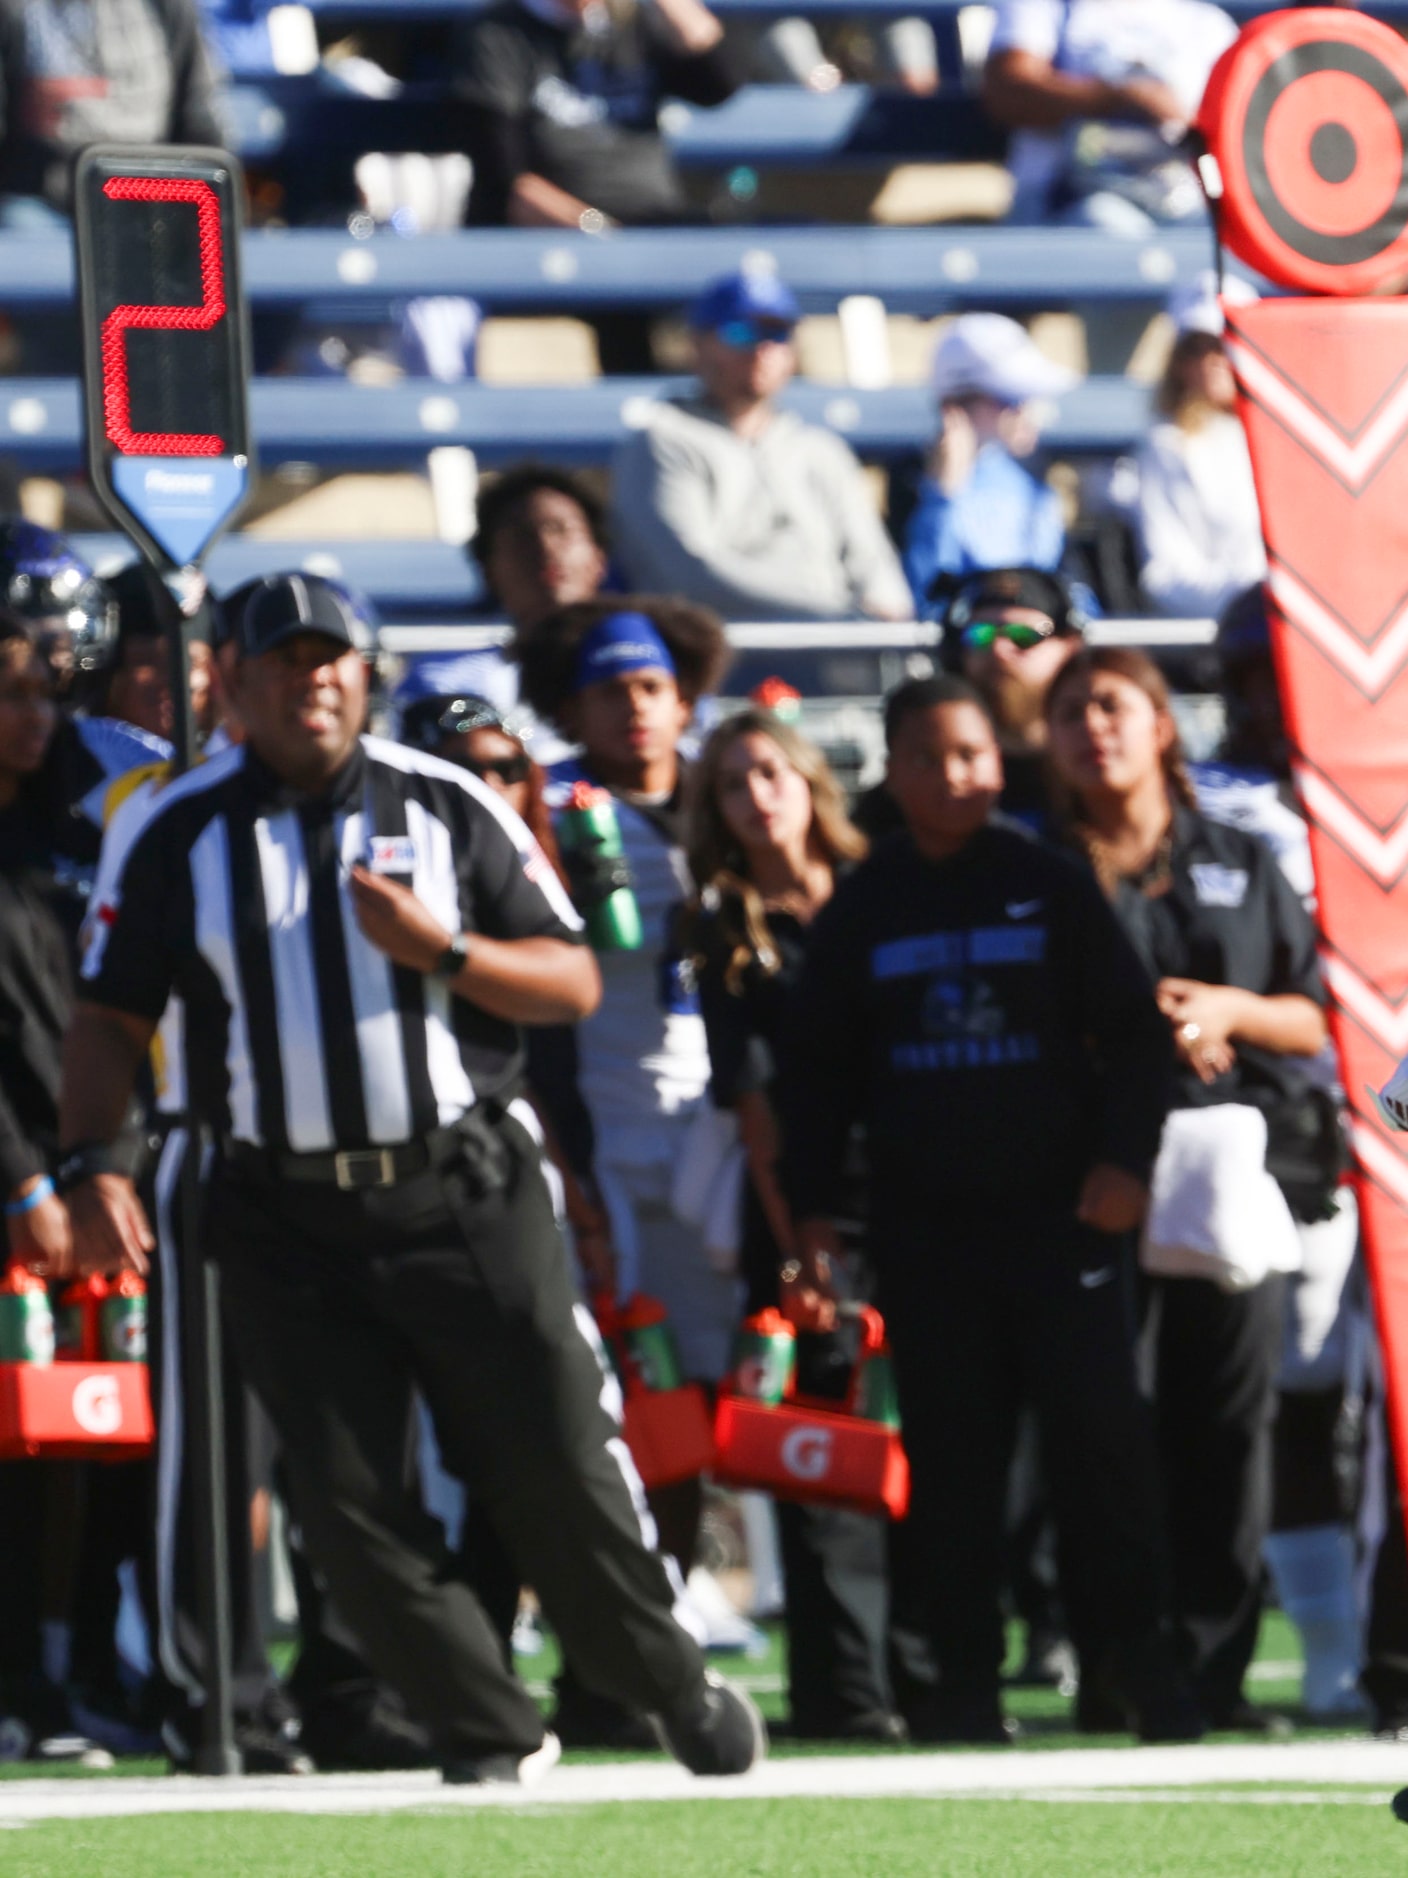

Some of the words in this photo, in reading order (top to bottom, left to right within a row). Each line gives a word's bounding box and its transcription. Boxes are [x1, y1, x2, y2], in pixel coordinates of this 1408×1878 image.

[102, 176, 226, 456] 2
[72, 1374, 123, 1436] G
[781, 1423, 834, 1480] G
